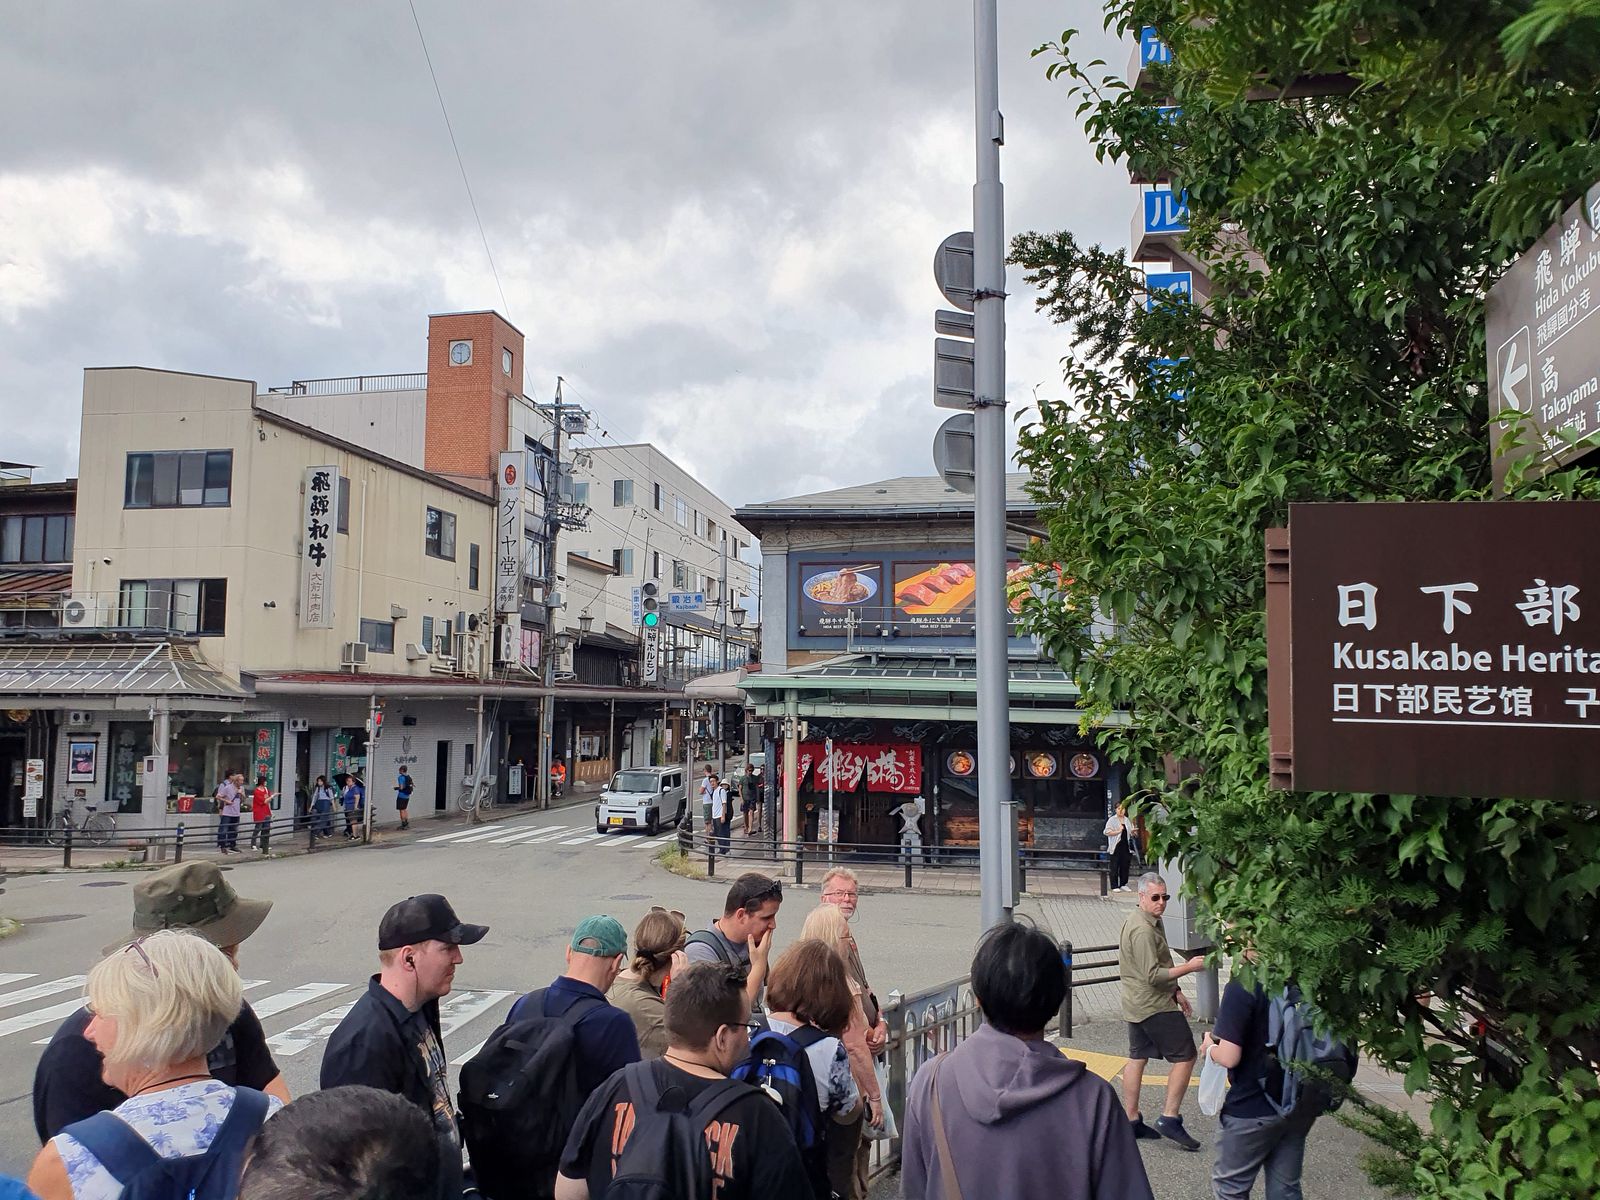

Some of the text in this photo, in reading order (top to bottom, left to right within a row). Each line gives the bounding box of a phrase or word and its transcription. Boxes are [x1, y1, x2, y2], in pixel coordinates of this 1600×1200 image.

[1536, 287, 1560, 319] Hida
[1541, 356, 1559, 398] 高
[1541, 377, 1599, 423] Takayama
[308, 471, 330, 567] 飛騨和牛
[499, 497, 518, 577] ダイヤ堂
[1336, 579, 1581, 635] 日下部
[1333, 642, 1600, 674] Kusakabe Herita
[1333, 683, 1533, 717] 日下部民艺馆
